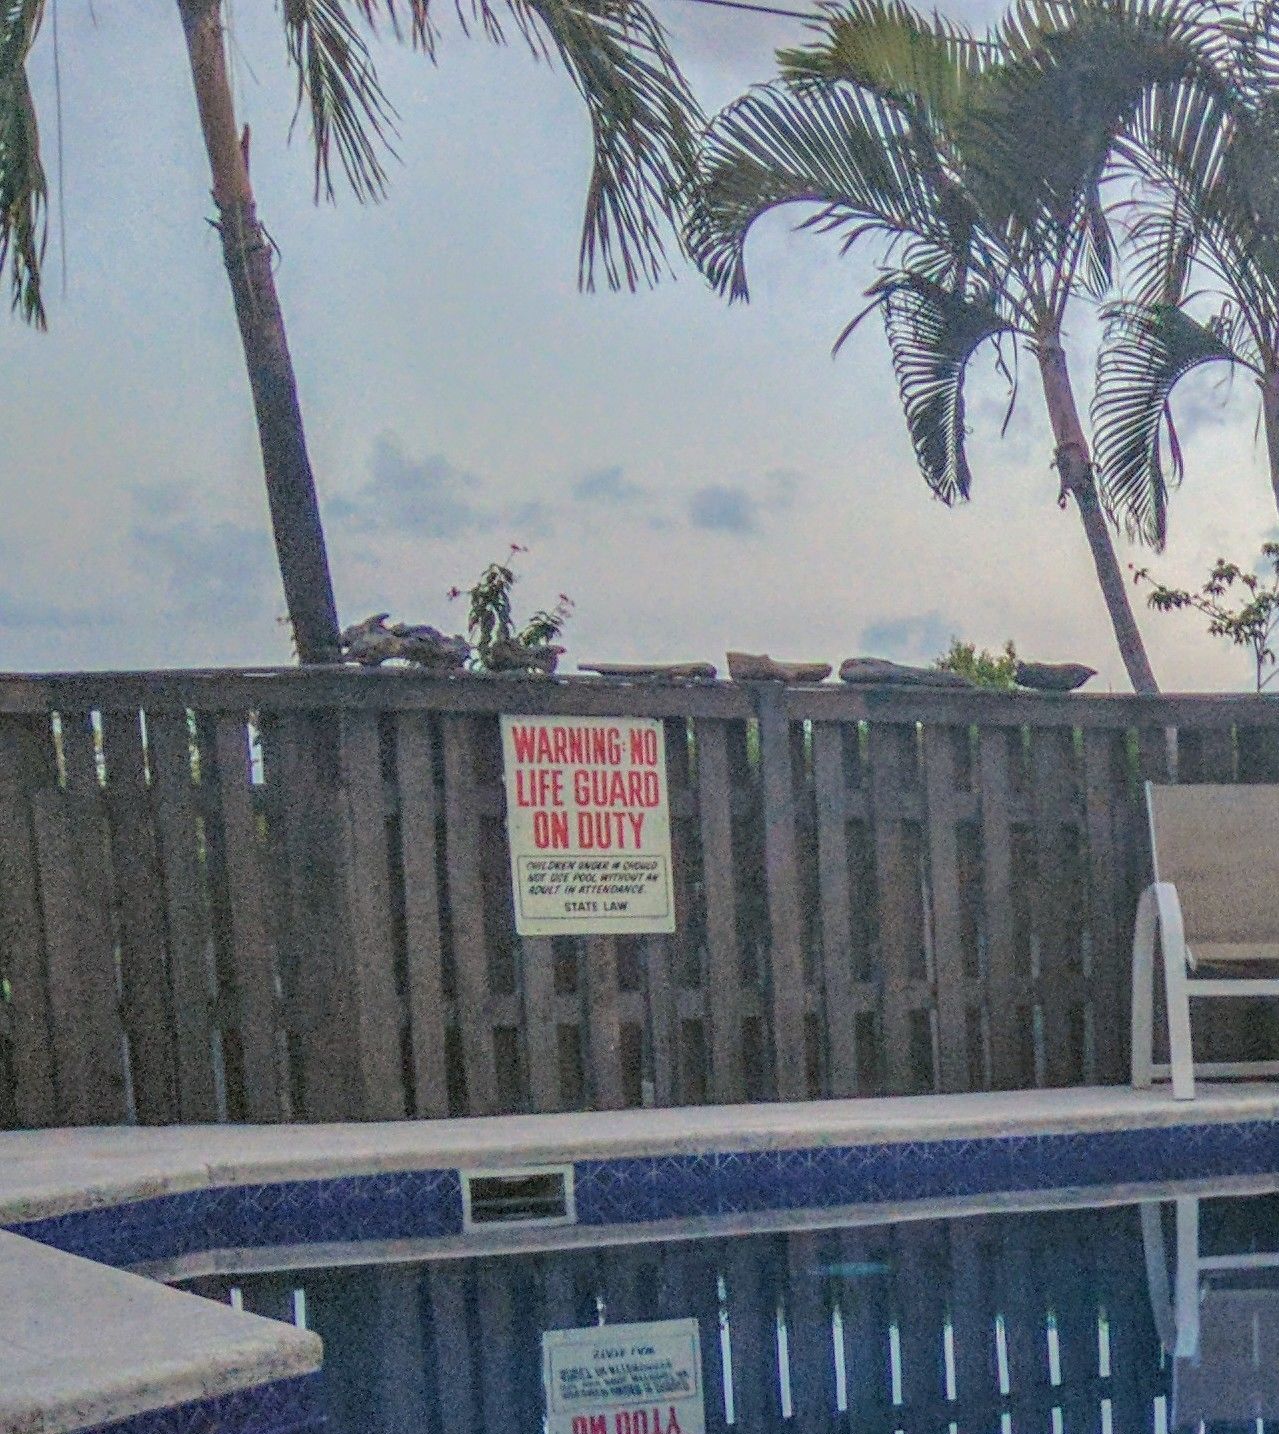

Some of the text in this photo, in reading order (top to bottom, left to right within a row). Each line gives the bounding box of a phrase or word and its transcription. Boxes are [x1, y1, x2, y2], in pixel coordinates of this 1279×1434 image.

[630, 727, 657, 766] NO
[515, 769, 660, 808] LIFE GUARD
[533, 811, 645, 849] ON DUTY
[527, 861, 576, 870] CHILDREN
[579, 861, 609, 870] UNDER
[623, 861, 658, 871] SHOULD
[527, 873, 658, 882] NOT USE POOL WITHOUT AN
[528, 885, 560, 895] ADULT
[564, 885, 576, 895] IN
[564, 901, 627, 912] STATE LAW
